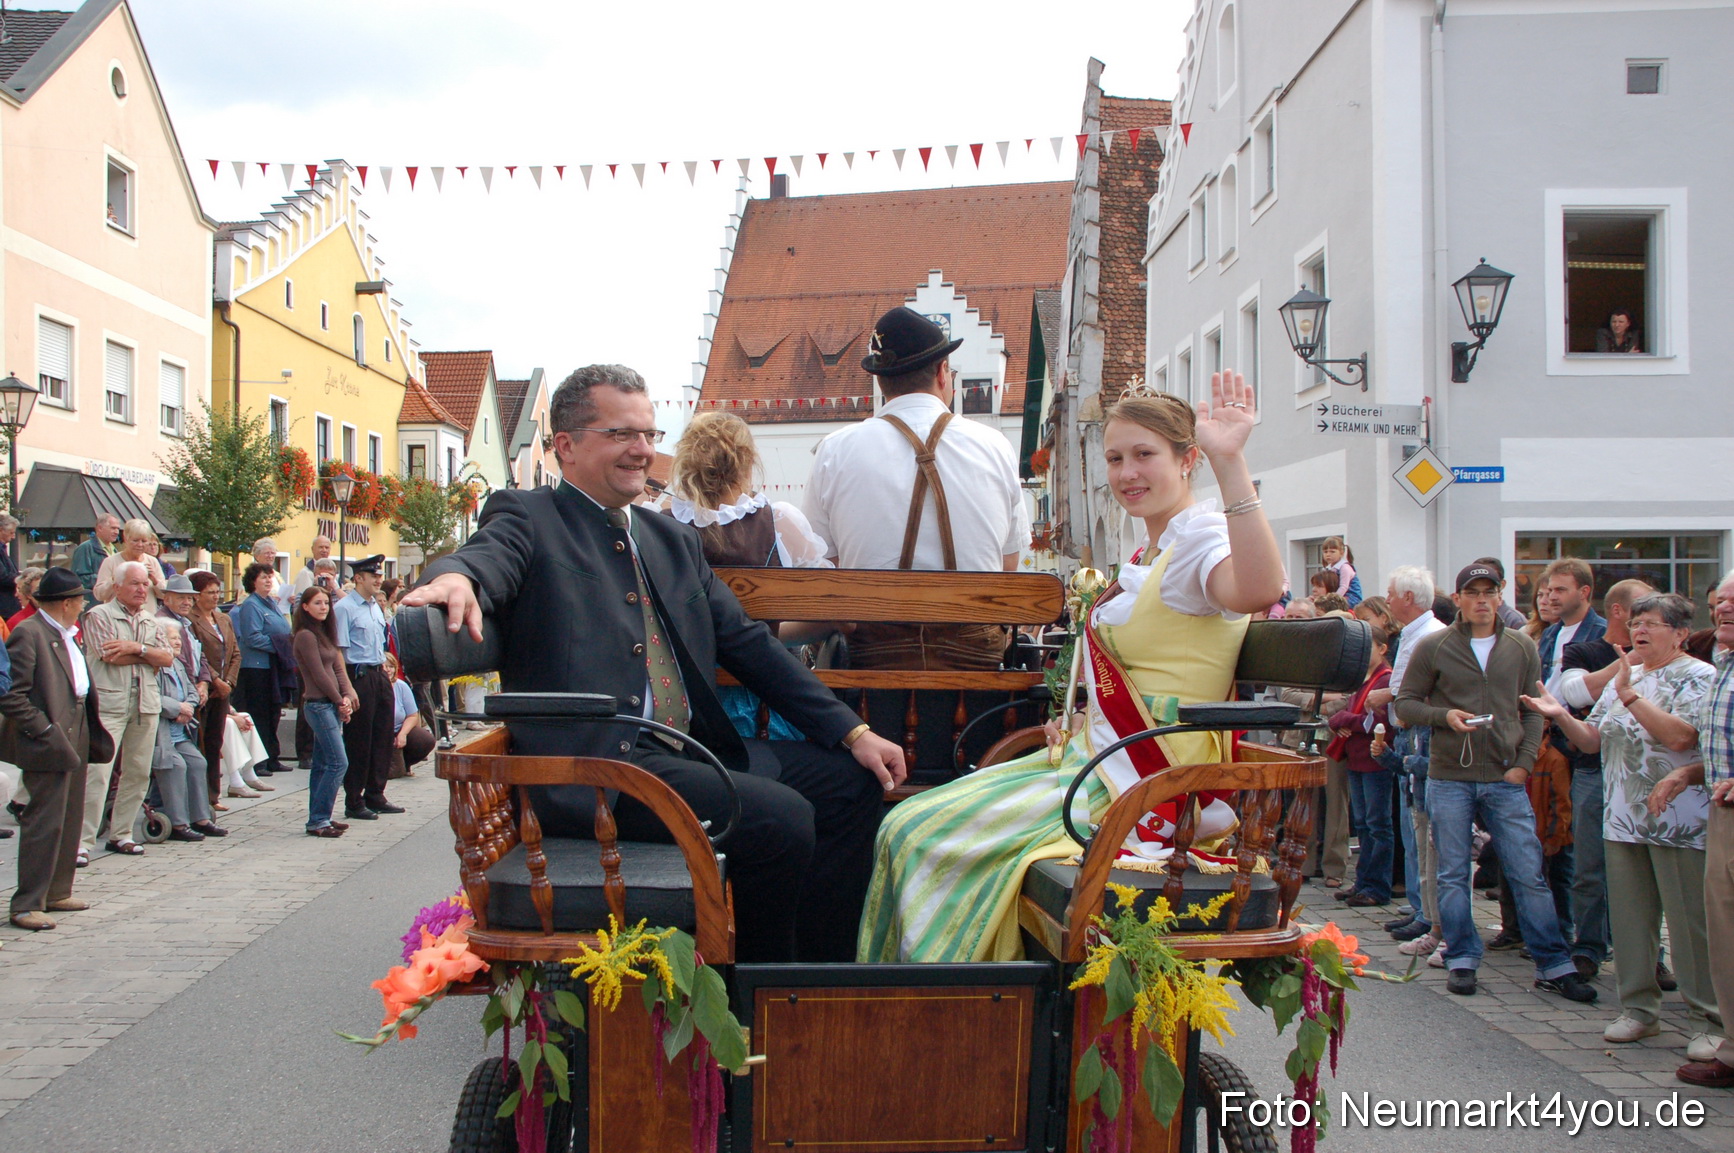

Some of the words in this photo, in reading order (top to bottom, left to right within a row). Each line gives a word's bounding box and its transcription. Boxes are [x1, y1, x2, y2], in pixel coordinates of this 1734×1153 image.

[1332, 404, 1383, 417] Bücherei
[1332, 421, 1370, 434] KERAMIK
[1373, 423, 1390, 434] UND
[1393, 424, 1417, 435] MEHR
[84, 460, 104, 476] BÜRO
[105, 466, 110, 478] &
[112, 467, 156, 485] SCHULBEDARF
[1453, 469, 1500, 482] Pfarrgasse
